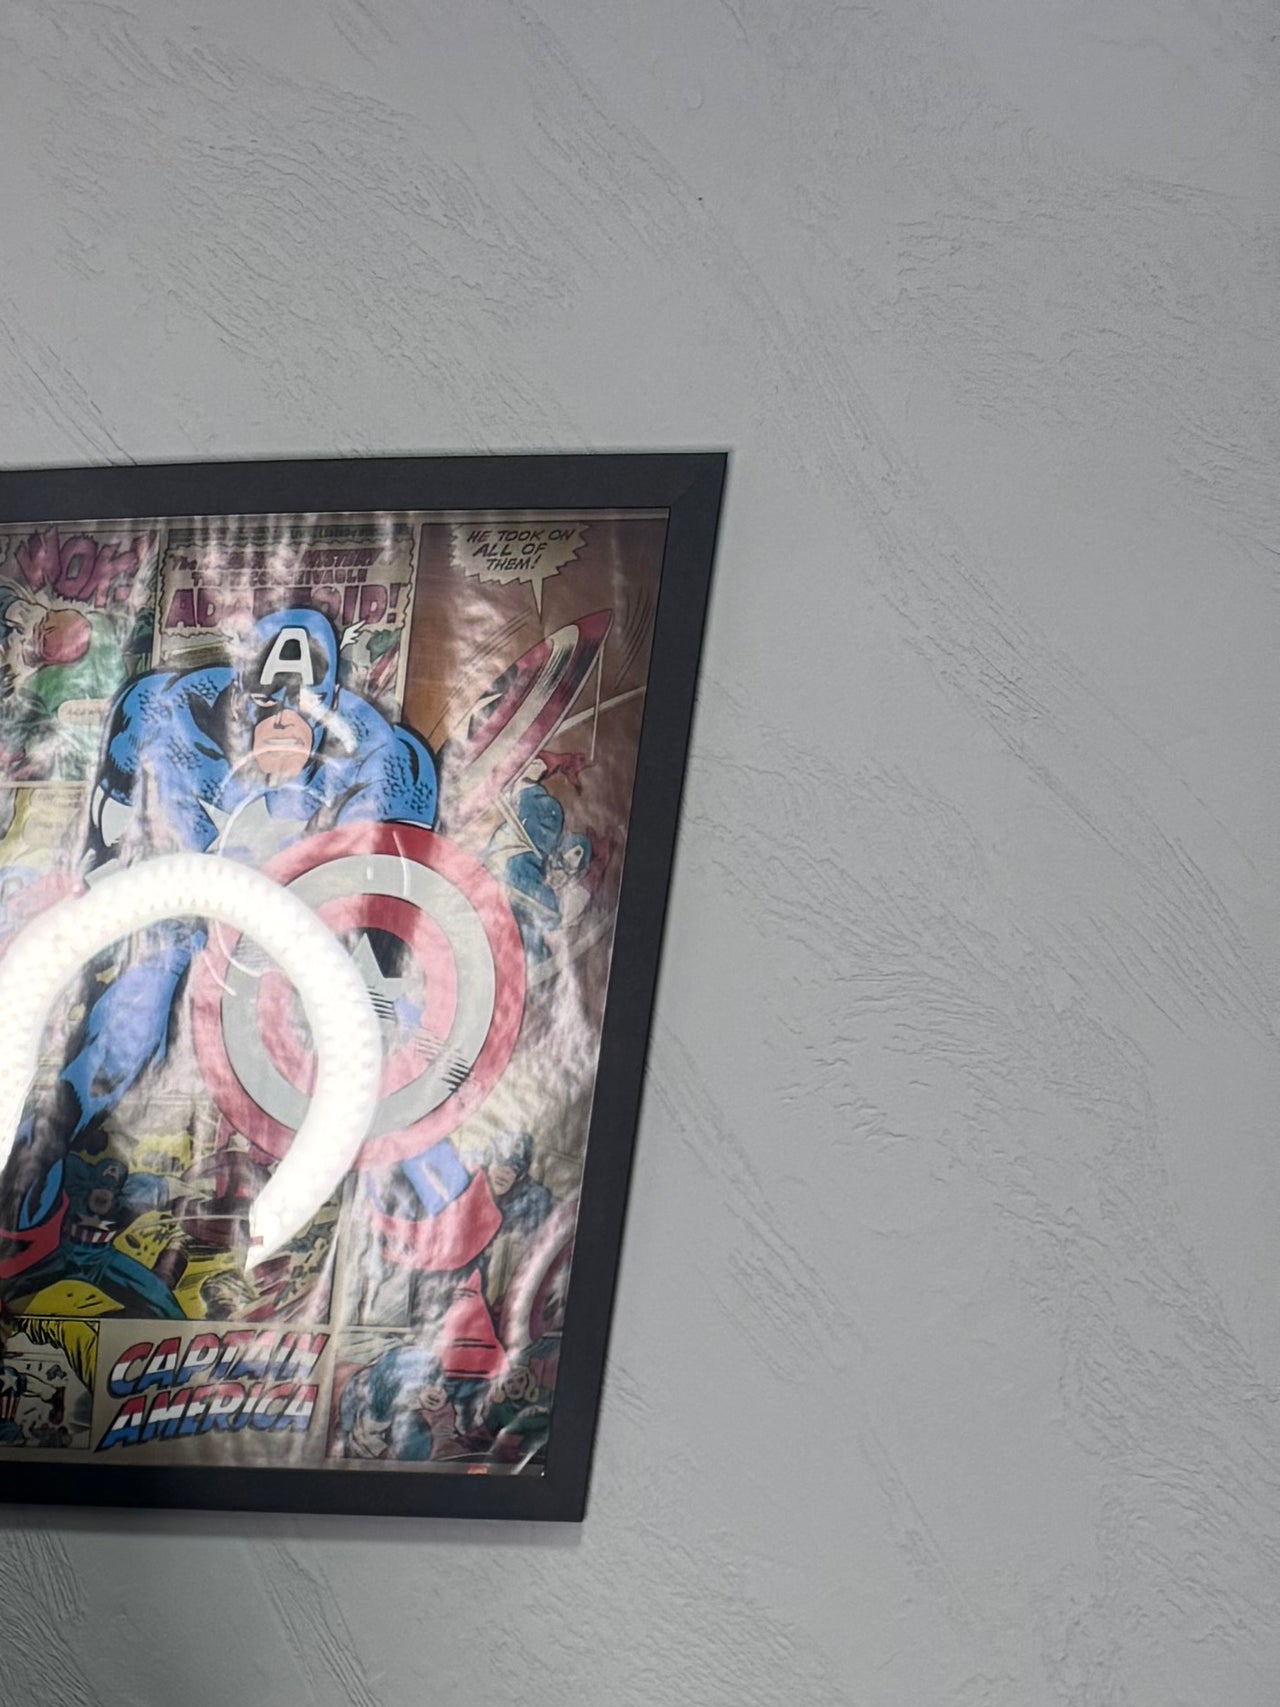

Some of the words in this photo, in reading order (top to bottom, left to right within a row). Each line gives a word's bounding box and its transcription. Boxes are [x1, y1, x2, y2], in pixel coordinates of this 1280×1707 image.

[467, 530, 489, 543] HE
[497, 529, 545, 542] TOOK
[548, 528, 577, 541] ON
[472, 543, 512, 558] ALL
[521, 542, 548, 555] OF
[486, 554, 542, 571] THEM!
[107, 1329, 330, 1398] CAPTAIN
[94, 1382, 319, 1453] AMERICA
